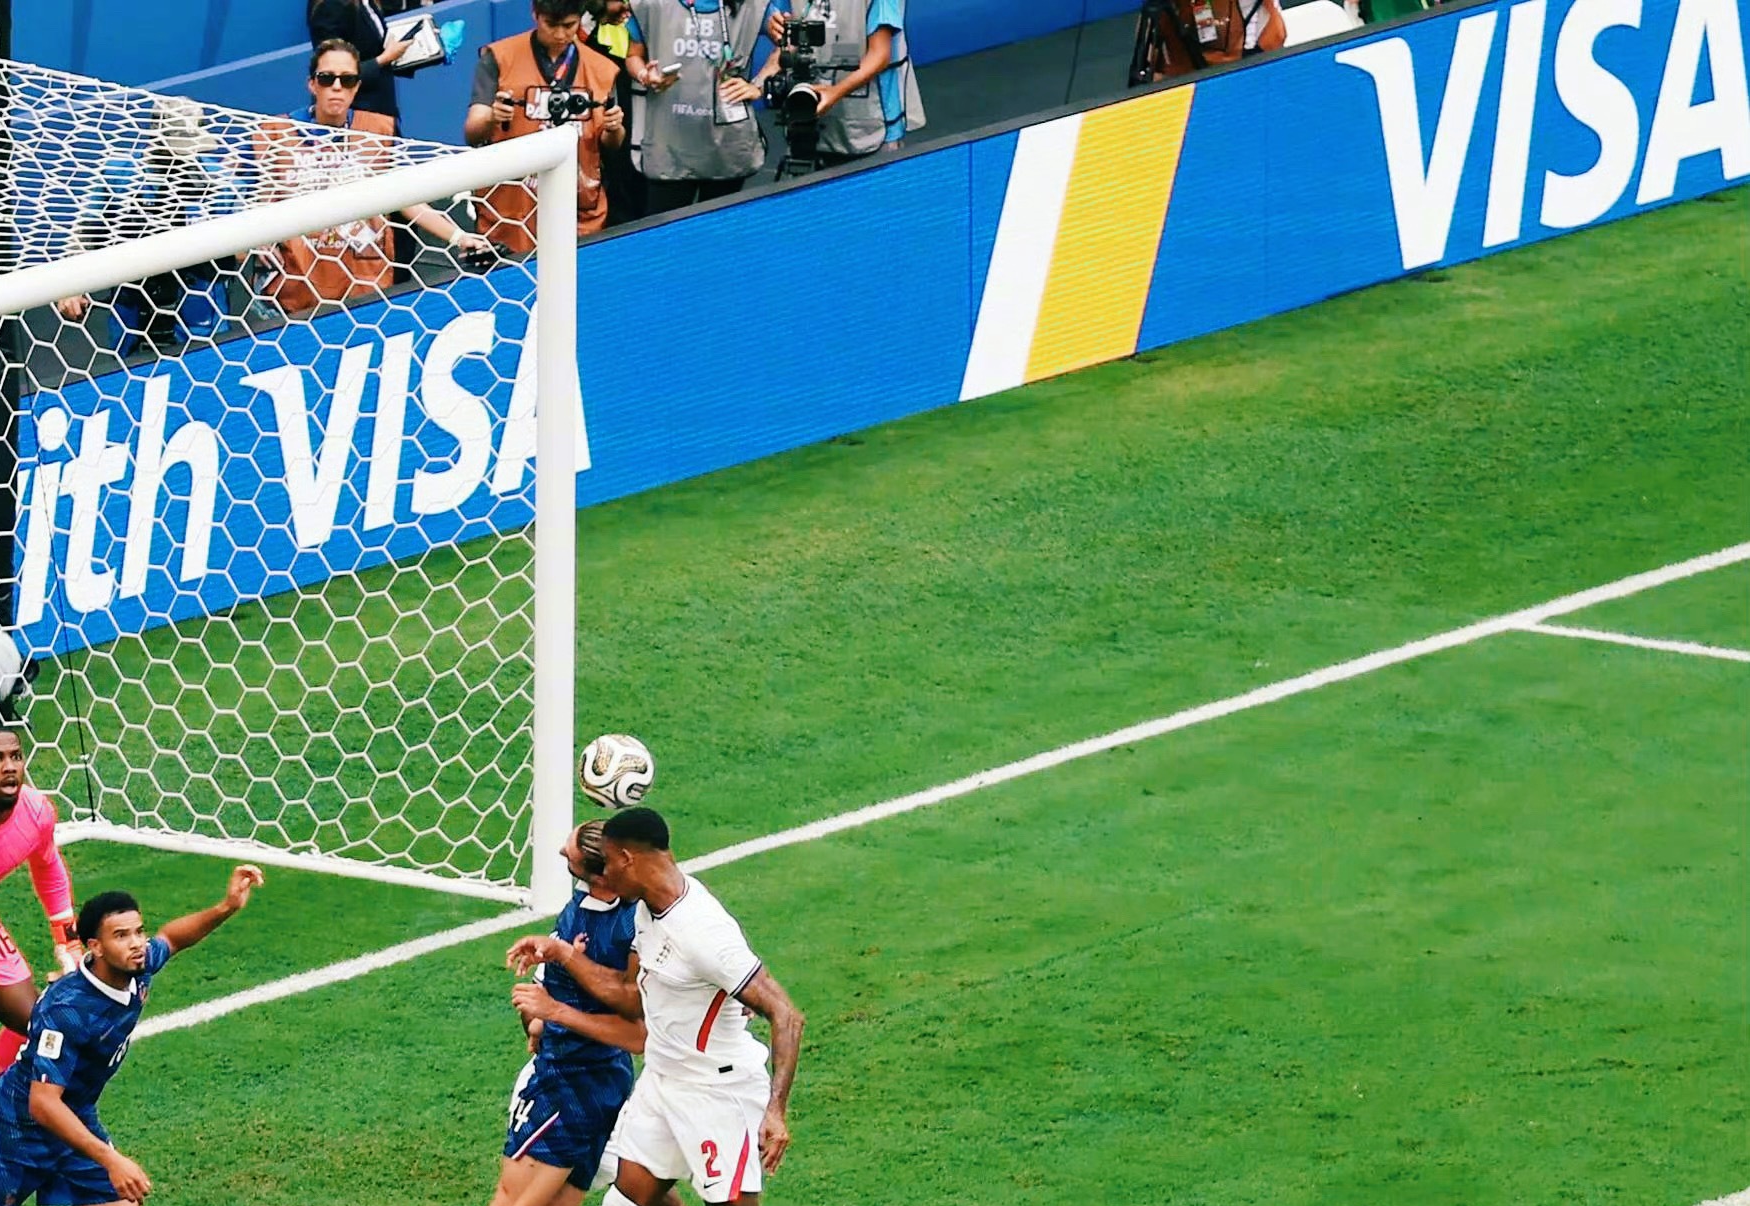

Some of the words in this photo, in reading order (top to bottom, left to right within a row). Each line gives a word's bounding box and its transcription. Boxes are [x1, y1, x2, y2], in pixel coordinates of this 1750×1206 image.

[672, 103, 714, 117] FIFA.co
[1334, 0, 1750, 270] VISA
[701, 1139, 722, 1178] 2
